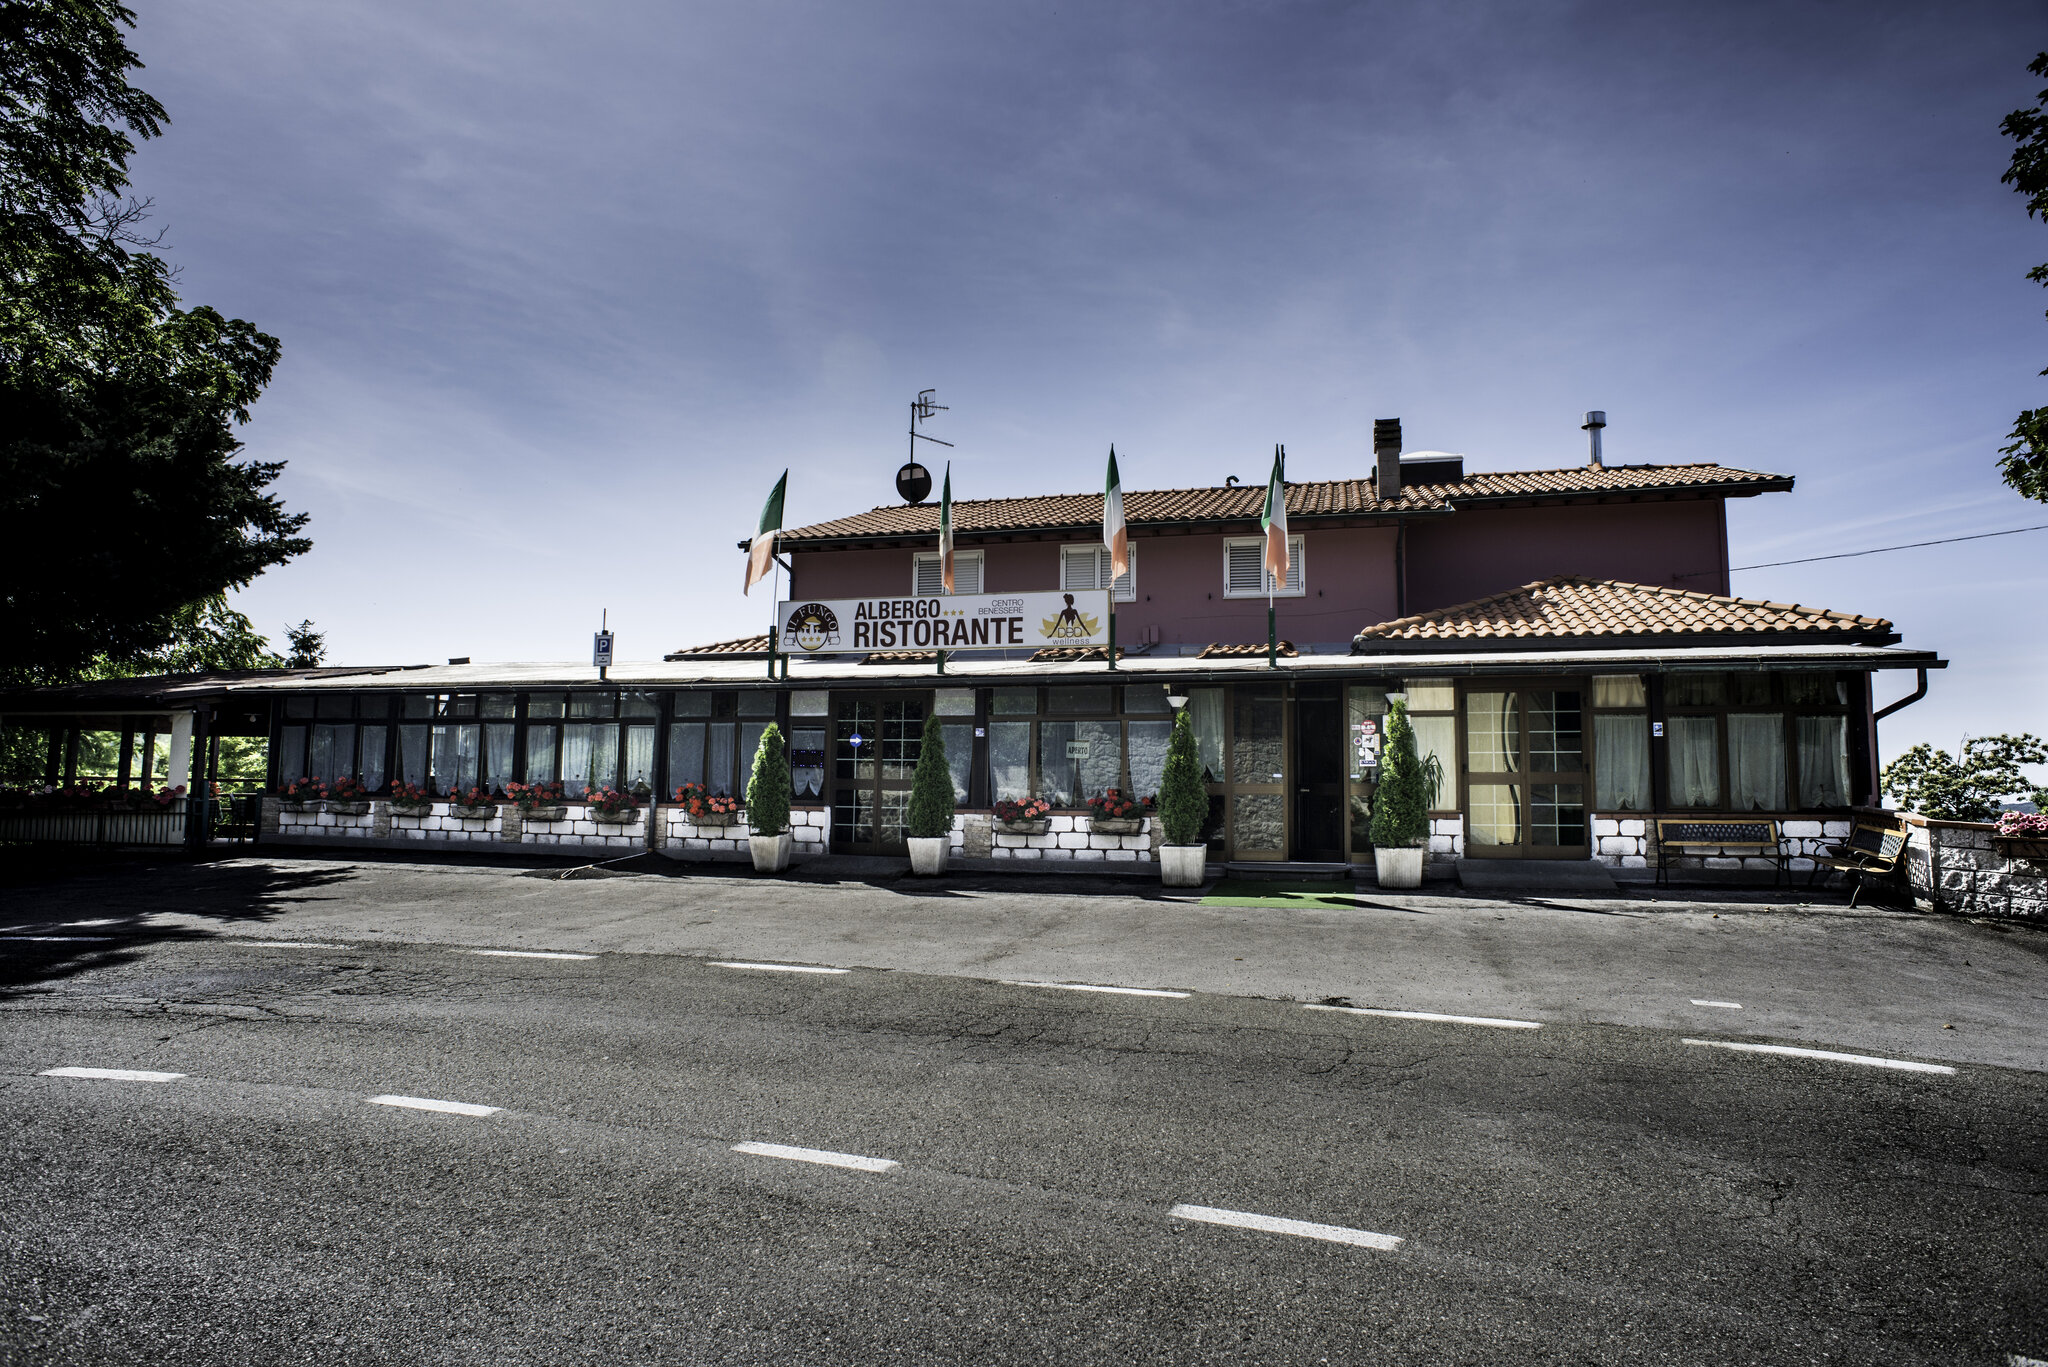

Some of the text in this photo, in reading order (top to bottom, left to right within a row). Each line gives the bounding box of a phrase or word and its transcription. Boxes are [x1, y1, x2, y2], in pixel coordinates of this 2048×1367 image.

[991, 599, 1024, 607] CENTRO
[854, 599, 941, 620] ALBERGO
[978, 606, 1024, 615] BENESSERE
[787, 604, 838, 631] IL FUNGO
[853, 617, 1024, 648] RISTORANTE
[599, 640, 608, 652] P
[1052, 637, 1090, 645] wellness
[1067, 746, 1088, 754] APERTO
